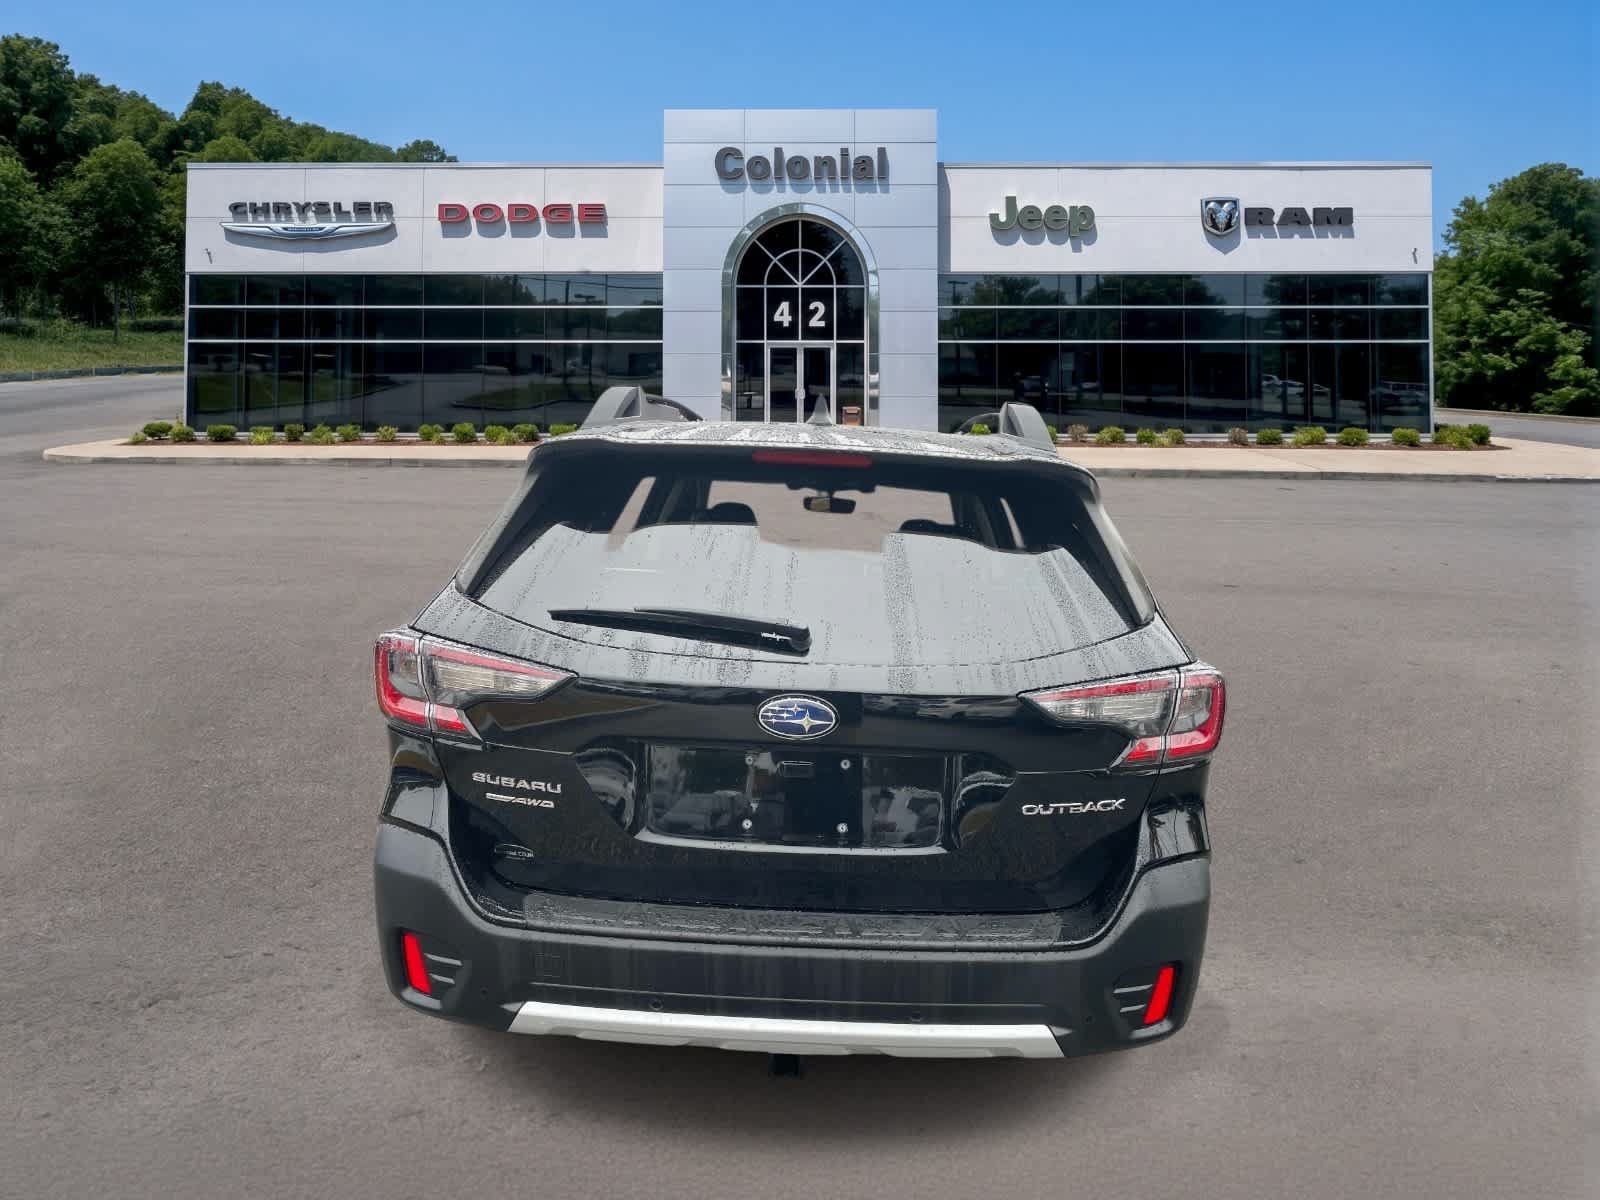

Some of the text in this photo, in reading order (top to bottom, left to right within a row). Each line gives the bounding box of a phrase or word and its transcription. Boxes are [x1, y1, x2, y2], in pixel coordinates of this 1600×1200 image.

[715, 146, 888, 180] Colonial
[228, 201, 393, 216] CHRYSLER
[438, 203, 606, 223] DODGE
[989, 195, 1096, 237] Jeep
[1244, 207, 1354, 226] RAM
[472, 772, 562, 794] SUBARU
[512, 797, 555, 809] AWD
[1022, 798, 1126, 815] OUTBACK
